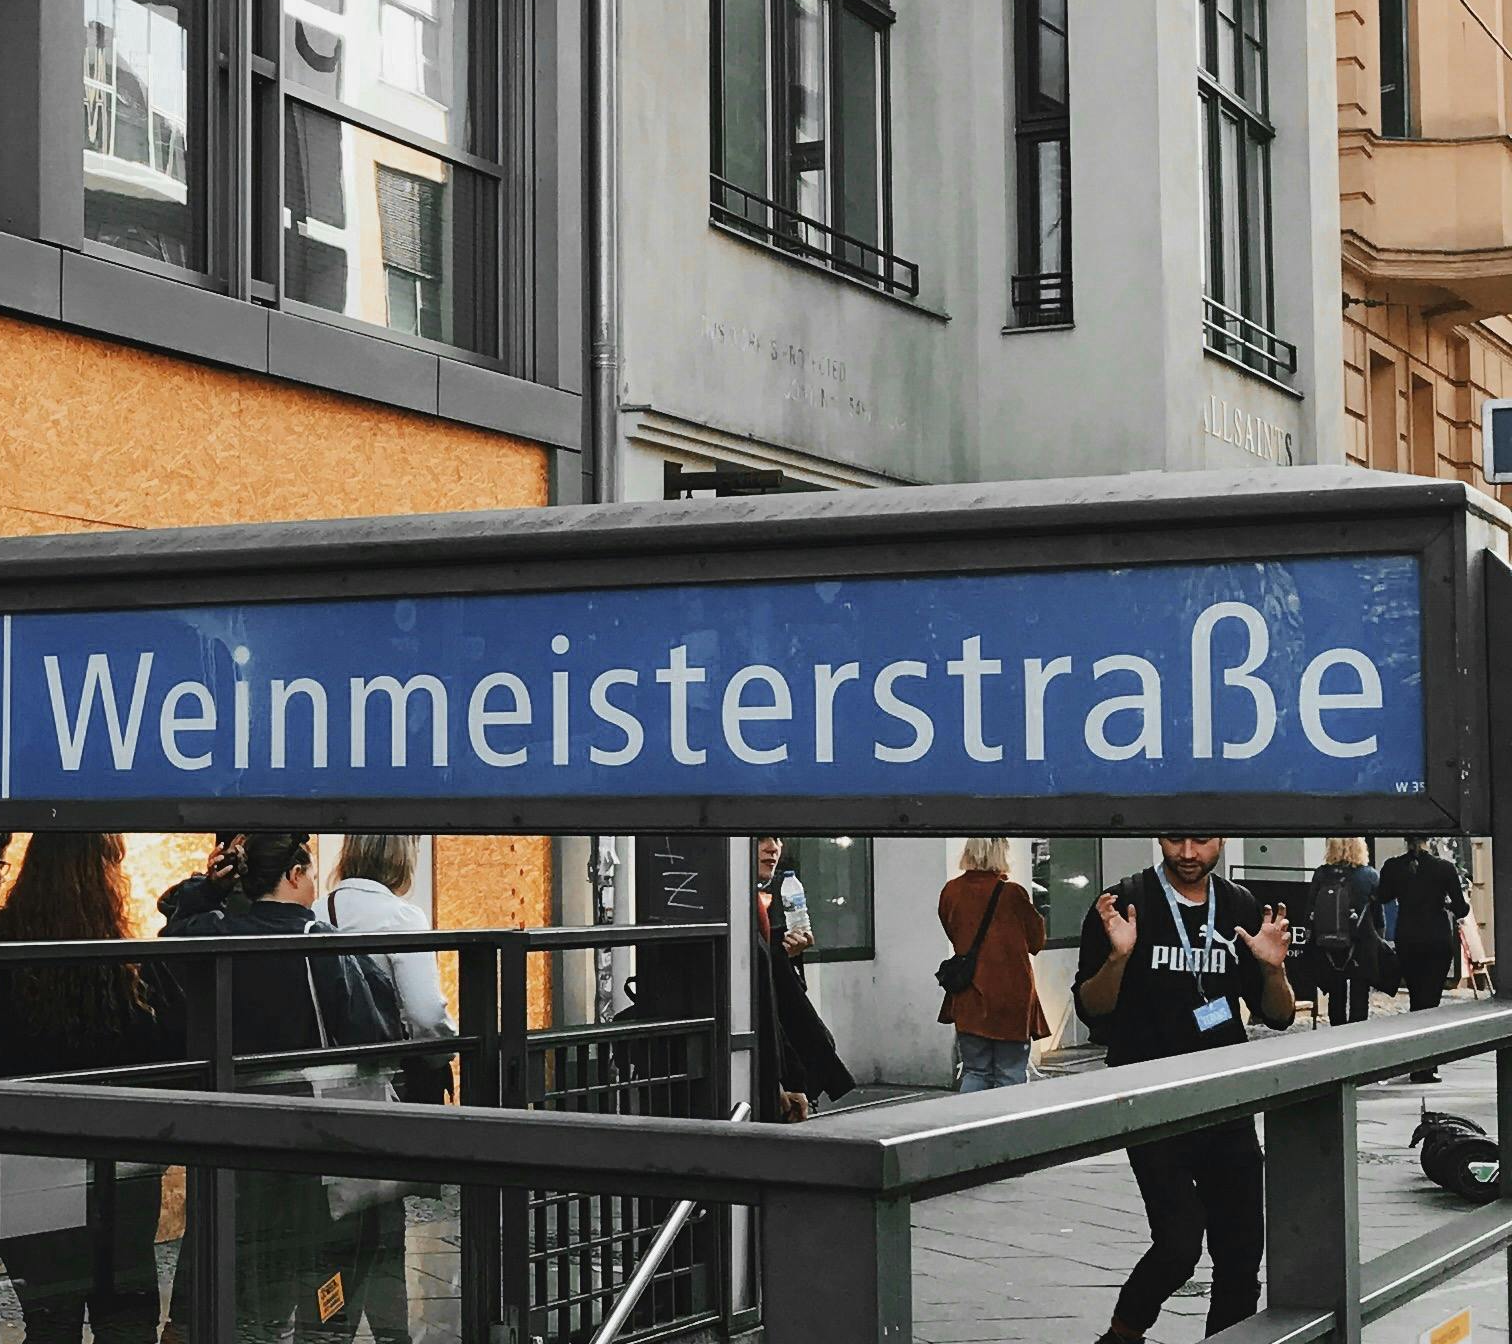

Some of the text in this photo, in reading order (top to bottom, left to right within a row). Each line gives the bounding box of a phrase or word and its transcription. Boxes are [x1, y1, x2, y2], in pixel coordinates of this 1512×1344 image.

[44, 602, 1382, 770] Weinmeisterstraße
[1396, 782, 1408, 792] W
[1152, 945, 1226, 973] PUMA
